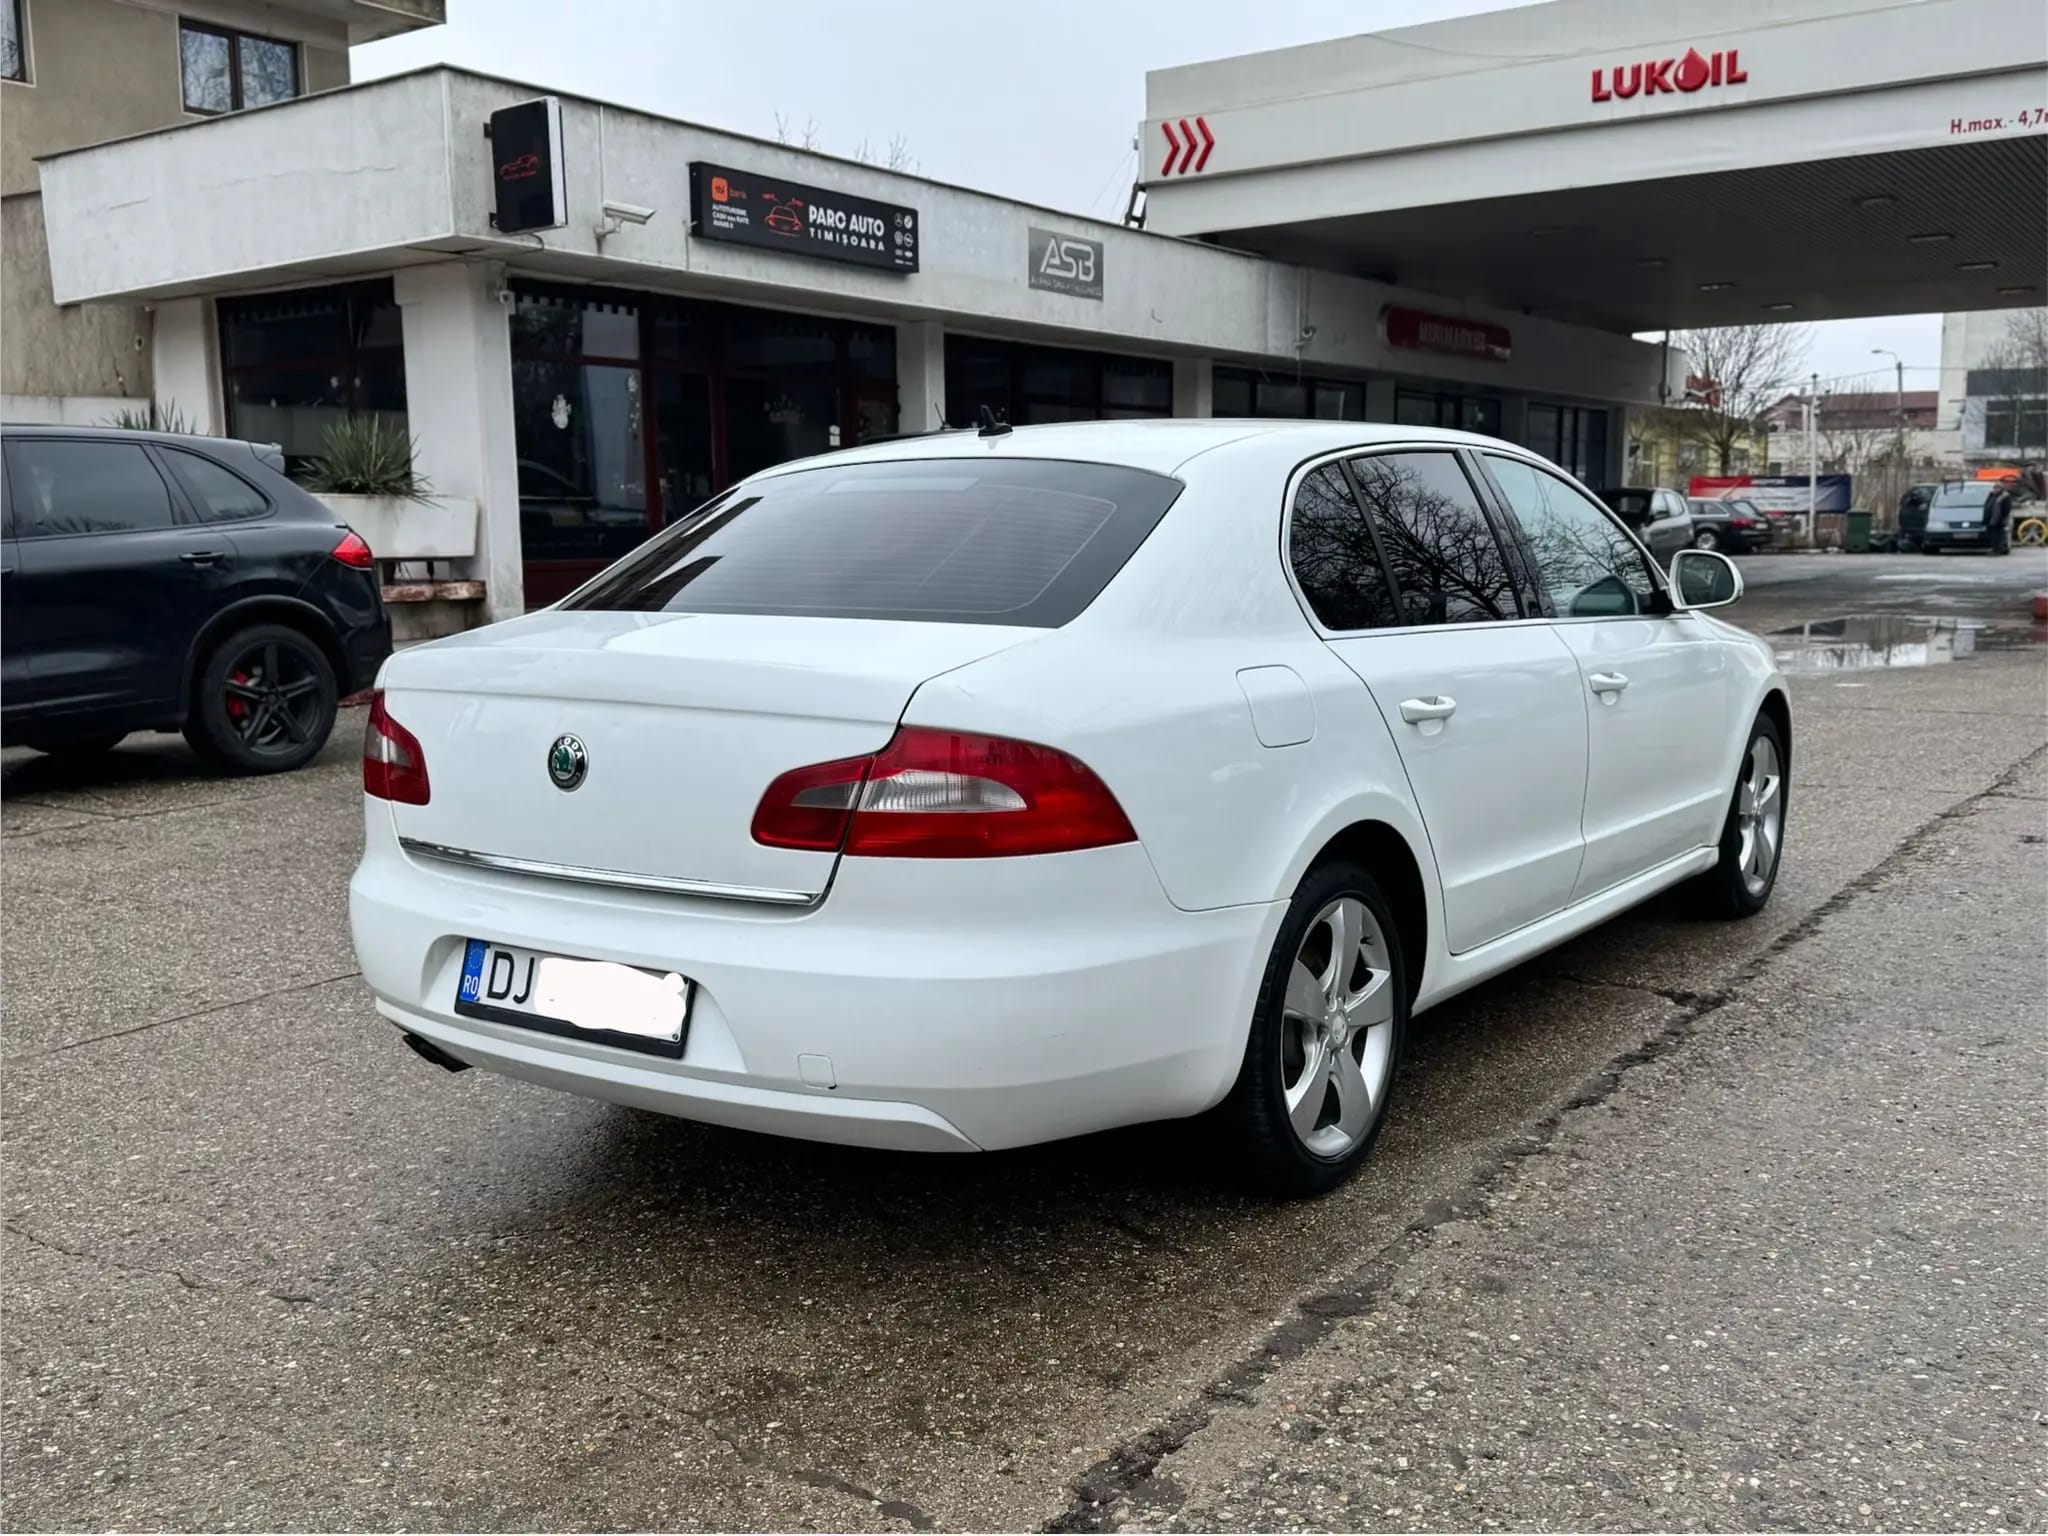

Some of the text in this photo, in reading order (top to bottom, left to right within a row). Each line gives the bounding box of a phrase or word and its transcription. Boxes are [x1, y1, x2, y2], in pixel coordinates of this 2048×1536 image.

[1592, 47, 1748, 103] LUKOIL
[2018, 107, 2048, 129] 4,7
[809, 204, 885, 237] PARC AUTO
[1040, 238, 1094, 281] ASB
[462, 974, 479, 995] RO
[487, 950, 535, 1005] DJ
